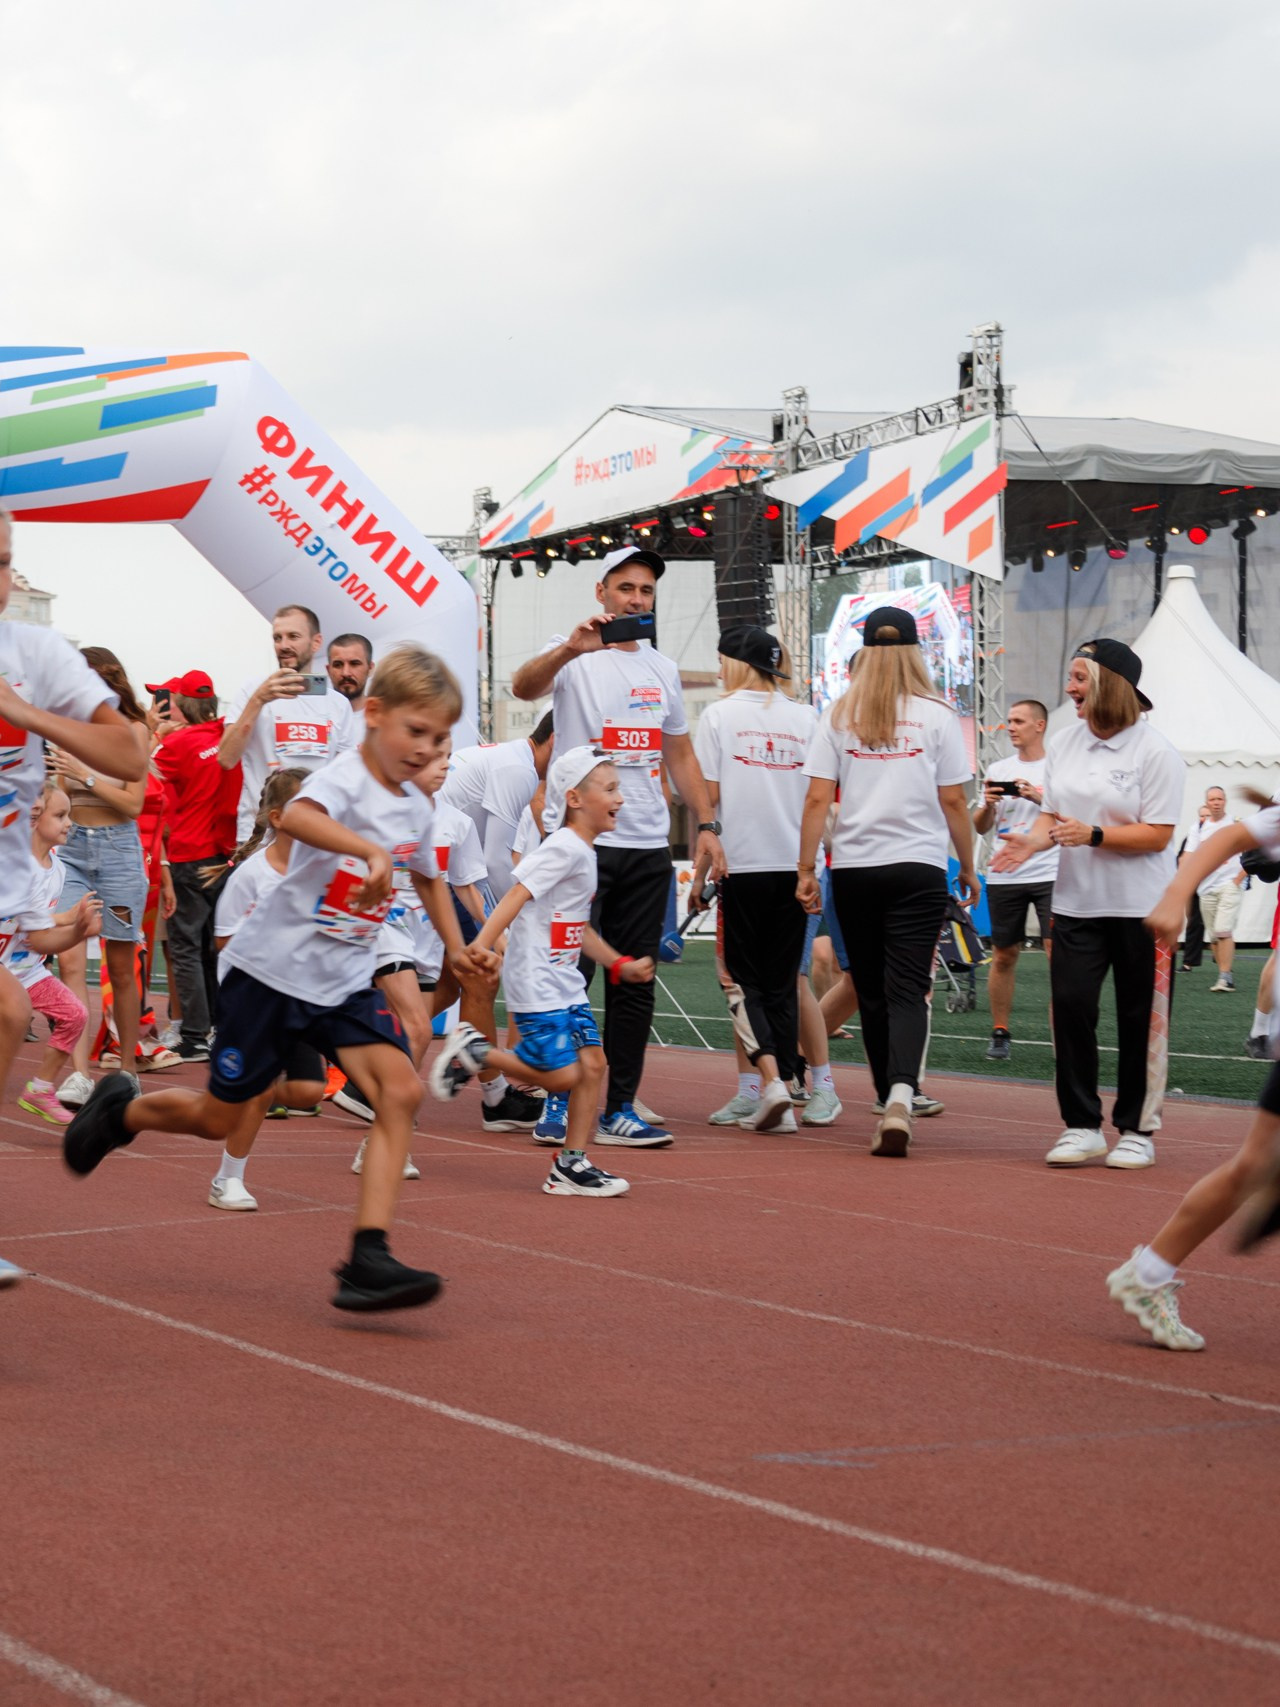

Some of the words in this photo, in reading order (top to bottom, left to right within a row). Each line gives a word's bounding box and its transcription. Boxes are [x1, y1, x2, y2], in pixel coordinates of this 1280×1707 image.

[256, 415, 440, 608] ФИНИШ
[287, 725, 318, 740] 258
[617, 731, 650, 748] 303
